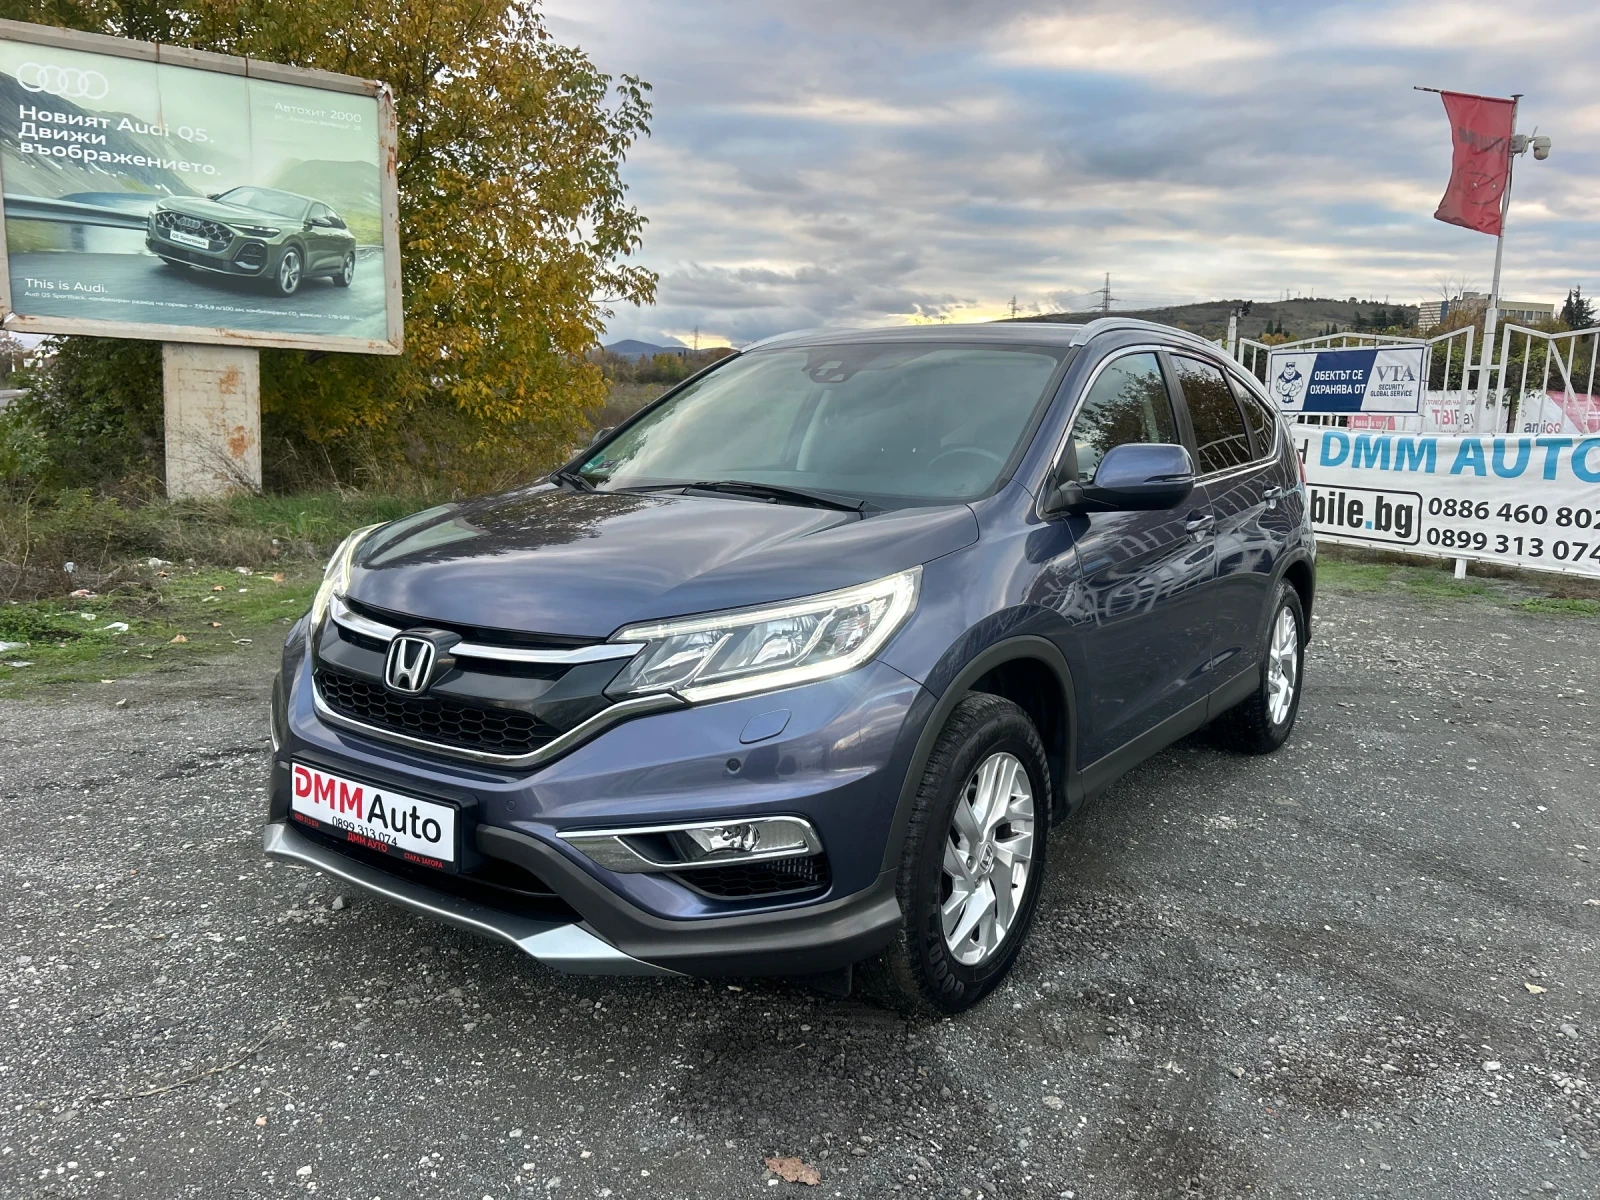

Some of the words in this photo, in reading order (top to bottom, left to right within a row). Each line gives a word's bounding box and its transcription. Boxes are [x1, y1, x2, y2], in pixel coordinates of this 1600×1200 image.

[274, 102, 326, 117] Автохит
[330, 110, 362, 123] 2000
[18, 122, 107, 146] Движи
[19, 104, 111, 130] Новият
[116, 117, 170, 138] Audi
[177, 125, 215, 144] Q5.
[20, 142, 222, 176] въображението.
[24, 278, 54, 290] This
[58, 280, 70, 291] is
[73, 281, 108, 294] Audi.
[1314, 370, 1351, 381] ОБЕКТЪТ
[1352, 369, 1364, 380] СЕ
[1375, 366, 1416, 382] VTA
[1309, 384, 1352, 395] ОХРАНЯВА
[1354, 383, 1366, 394] ОТ
[1378, 383, 1405, 391] SECURITY
[1390, 389, 1413, 397] SERVICE
[1320, 430, 1438, 474] DMM
[1450, 437, 1600, 483] AUTO
[1428, 497, 1490, 520] 0886
[1496, 502, 1548, 525] 460
[1426, 527, 1488, 551] 0899
[1494, 534, 1544, 557] 313
[1552, 540, 1600, 564] 074
[331, 815, 355, 832] 0899
[358, 824, 376, 839] 313
[378, 832, 398, 846] 074
[347, 831, 366, 845] ДММ
[367, 838, 388, 853] АУТО
[421, 857, 443, 869] ЗАГОРА
